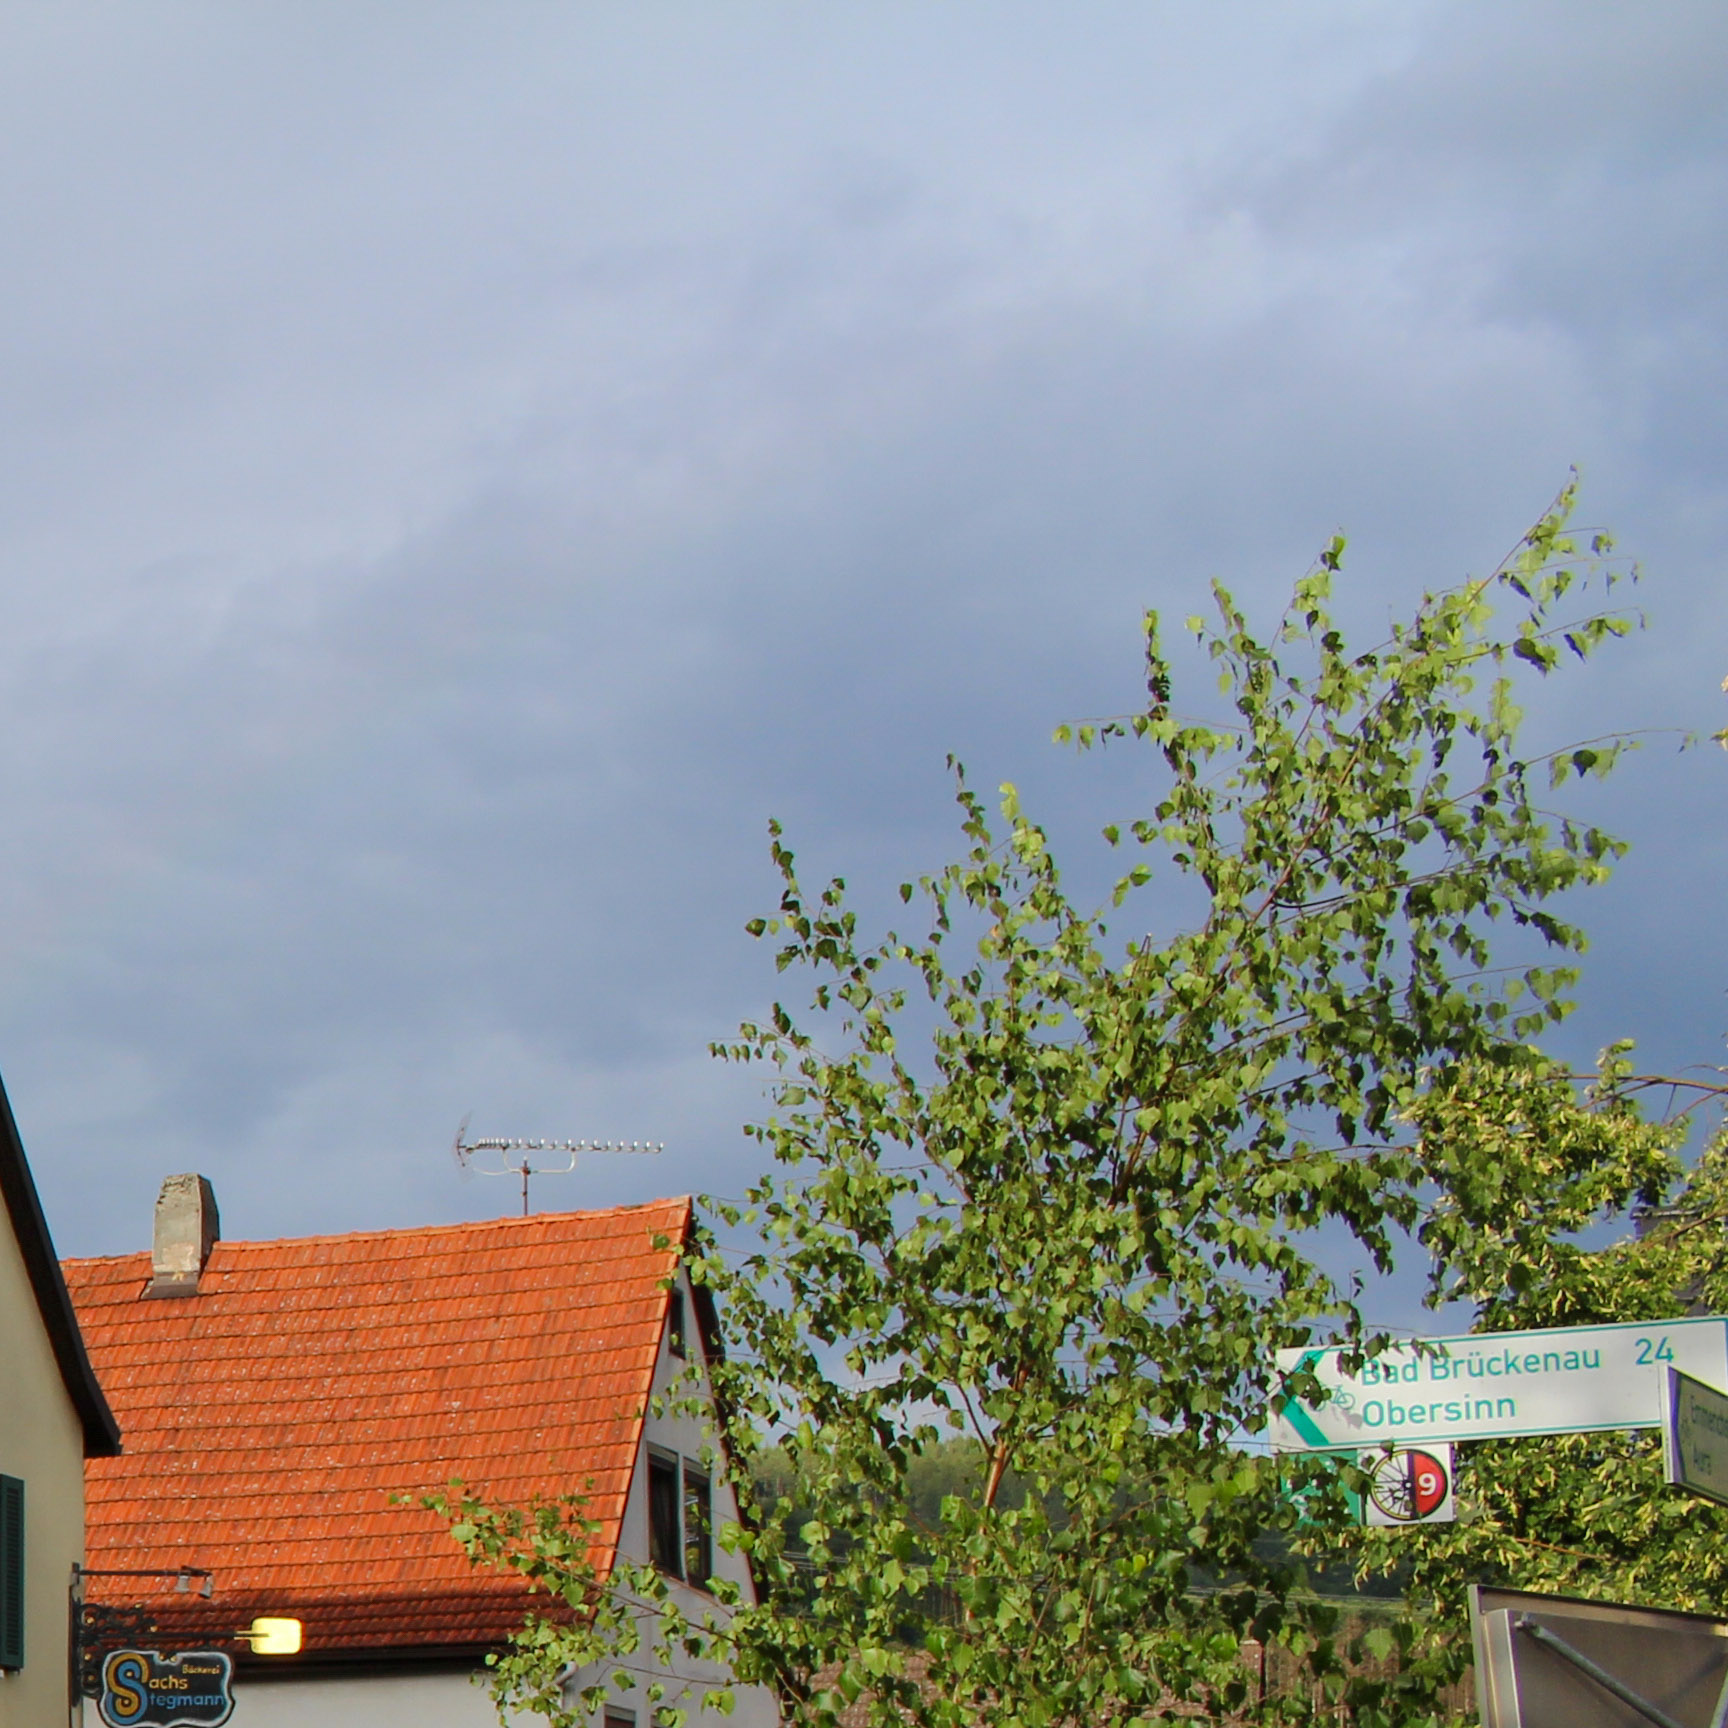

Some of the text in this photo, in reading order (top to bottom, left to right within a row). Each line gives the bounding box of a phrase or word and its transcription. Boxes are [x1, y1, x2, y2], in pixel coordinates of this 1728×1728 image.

[1361, 1336, 1675, 1386] Bad Brückenau 24
[1361, 1393, 1517, 1428] Obersinn
[1417, 1472, 1438, 1497] 9
[181, 1663, 222, 1676] Bäckerei
